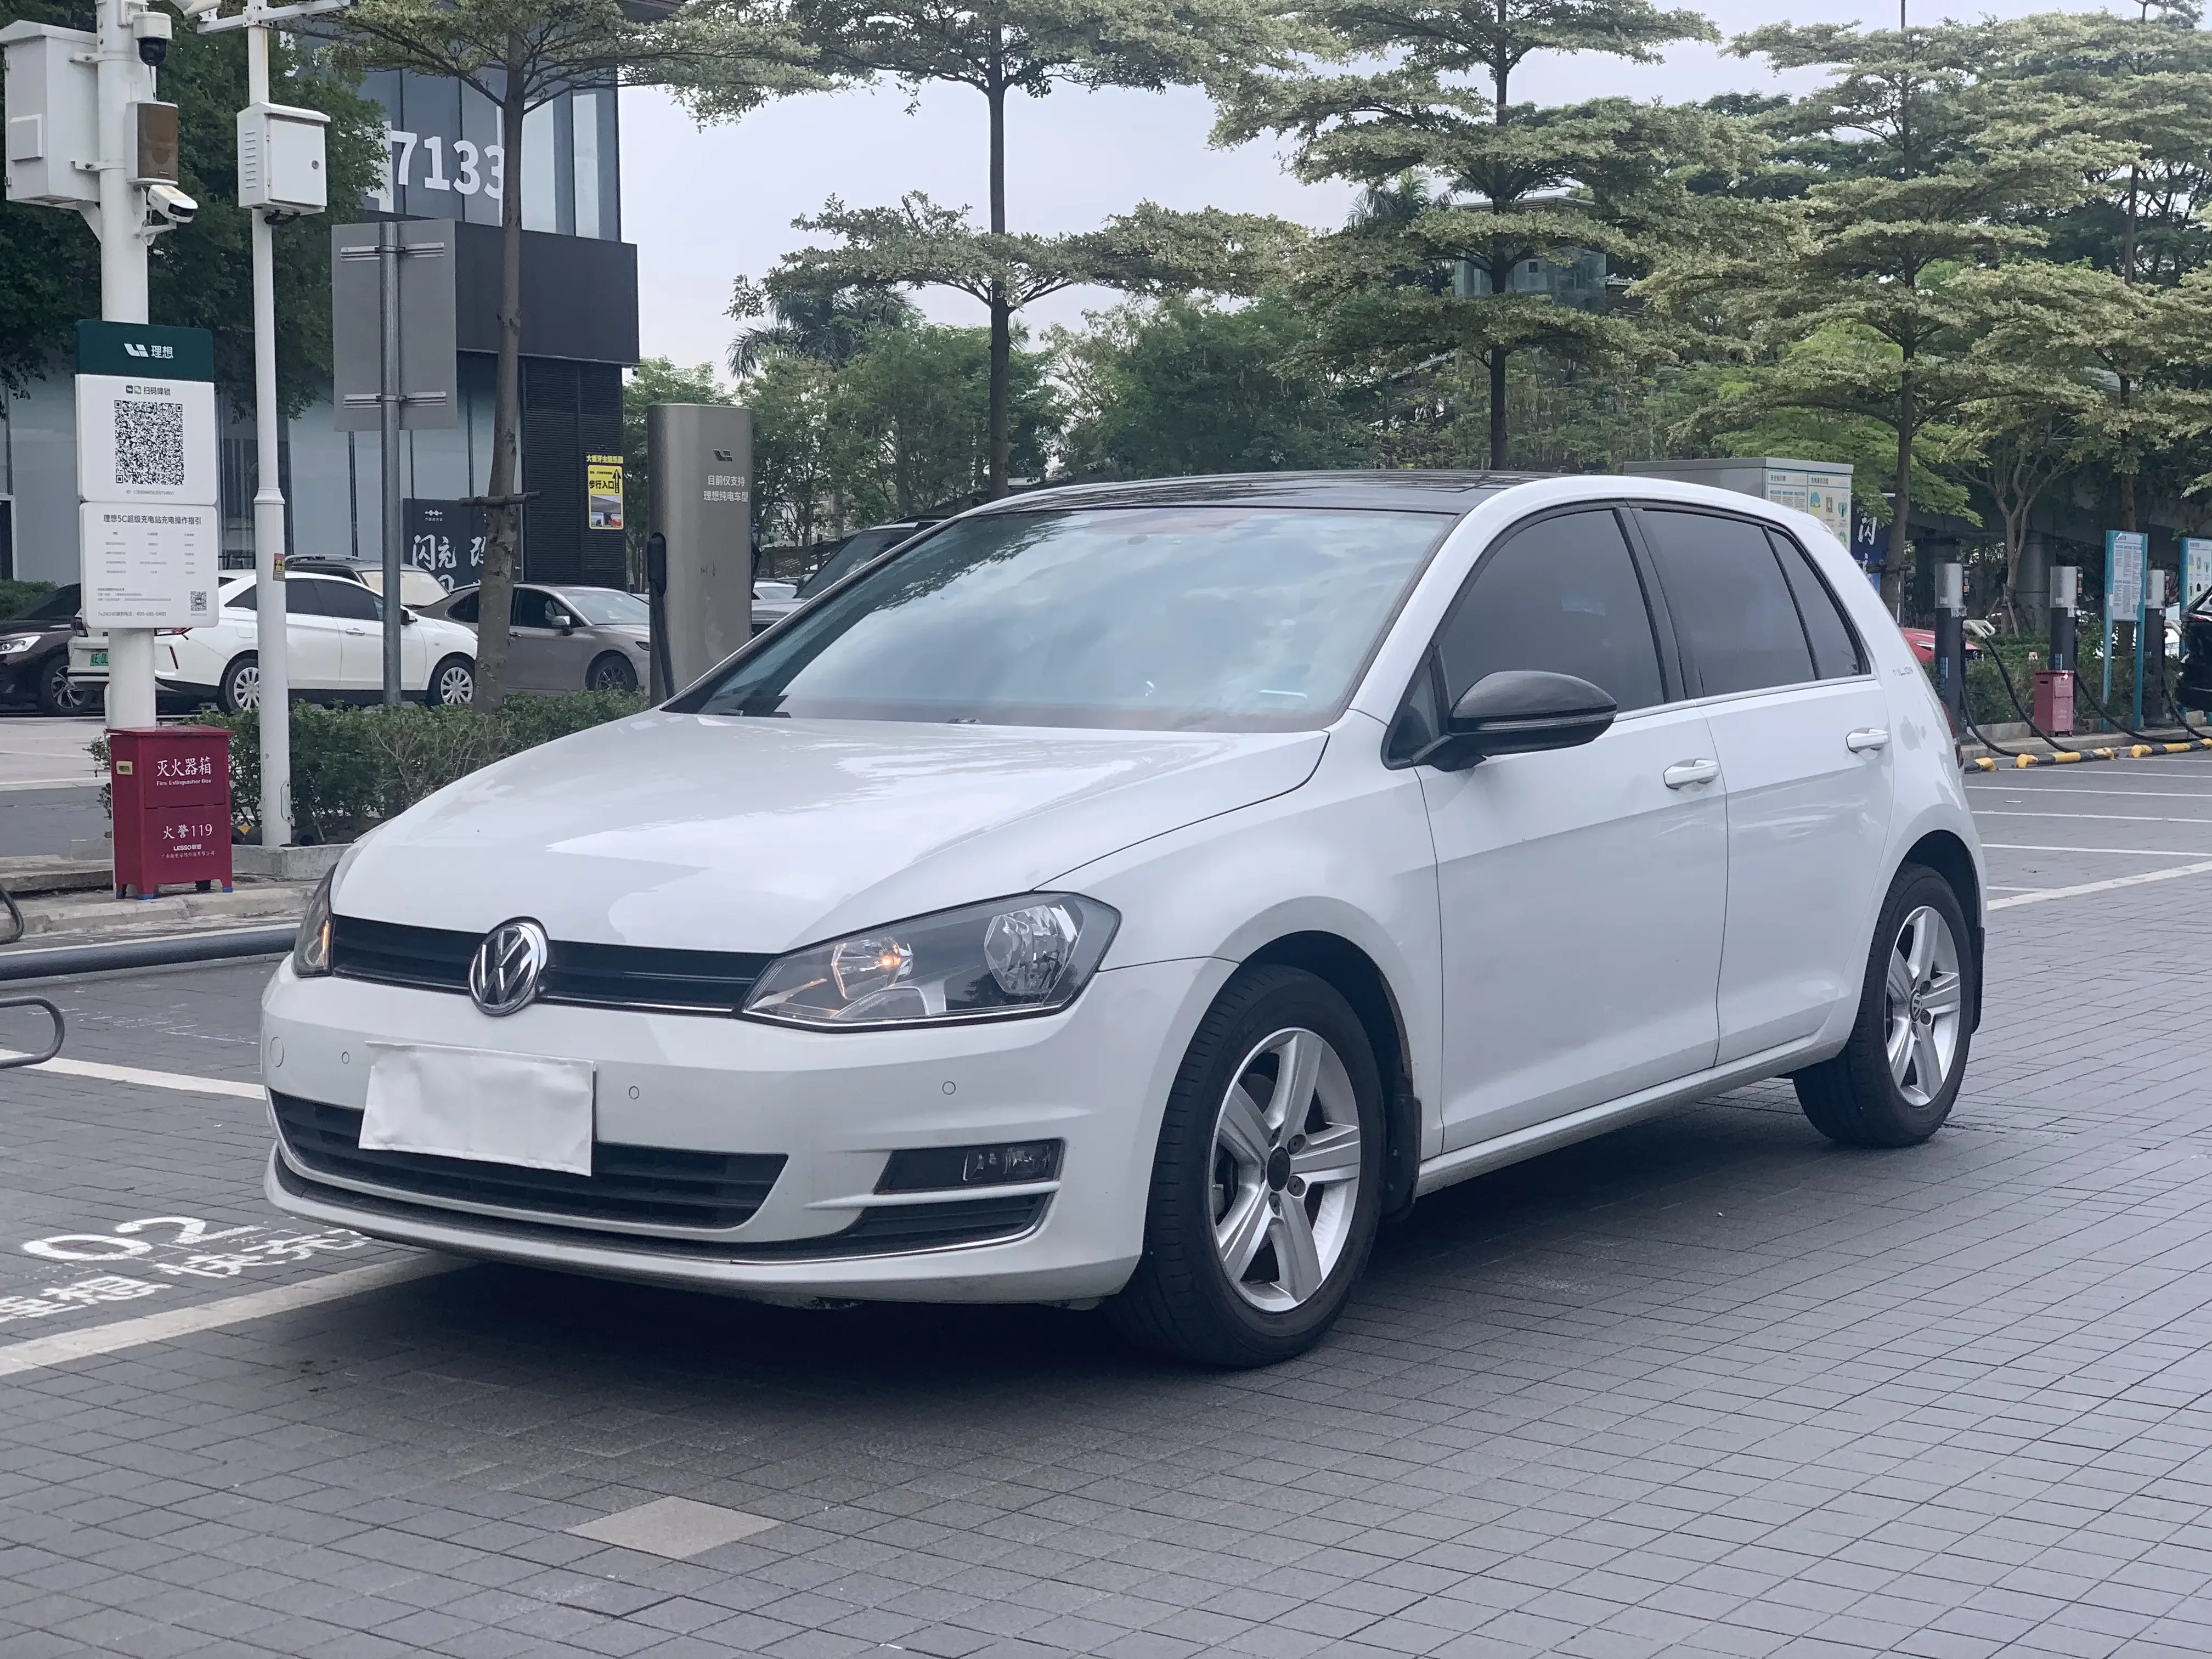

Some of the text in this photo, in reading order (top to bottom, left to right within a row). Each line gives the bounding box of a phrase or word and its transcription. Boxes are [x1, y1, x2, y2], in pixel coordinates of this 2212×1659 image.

[390, 130, 504, 199] 7133
[151, 345, 173, 359] 理想
[143, 386, 171, 396] 扫码降锁
[589, 480, 614, 489] 步行入口
[708, 475, 745, 487] 目前仅支持
[703, 490, 748, 502] 理想纯电车型
[103, 514, 201, 526] 理想5C超级充电站充电操作指引
[412, 534, 456, 571] 闪充
[157, 756, 211, 777] 灭火器箱
[22, 1216, 262, 1261] 02
